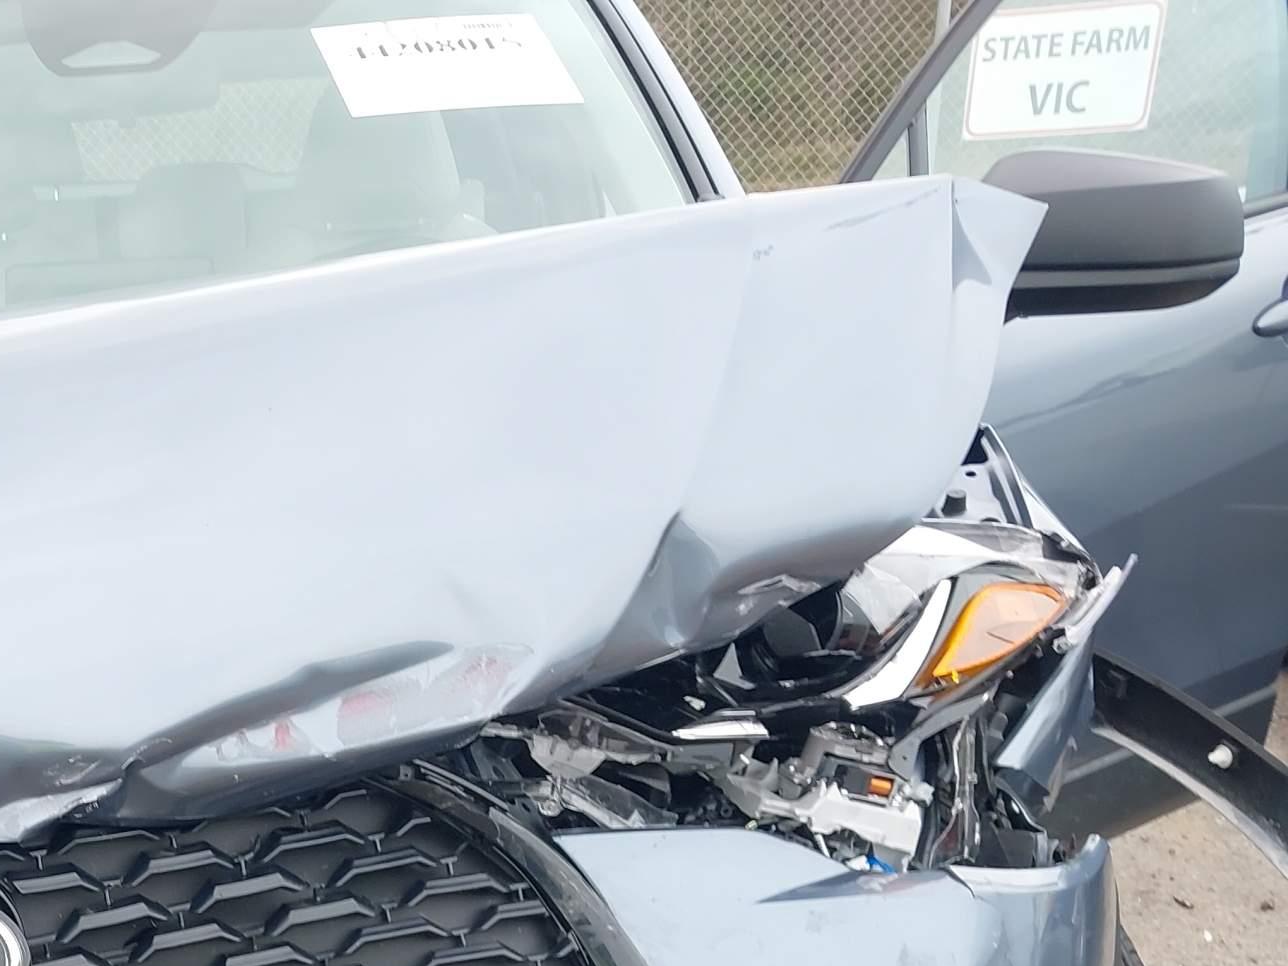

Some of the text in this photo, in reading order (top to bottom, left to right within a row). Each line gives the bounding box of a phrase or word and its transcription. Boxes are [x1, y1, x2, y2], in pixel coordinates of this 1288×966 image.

[982, 25, 1151, 63] STATE FARM
[1028, 80, 1090, 117] VIC
